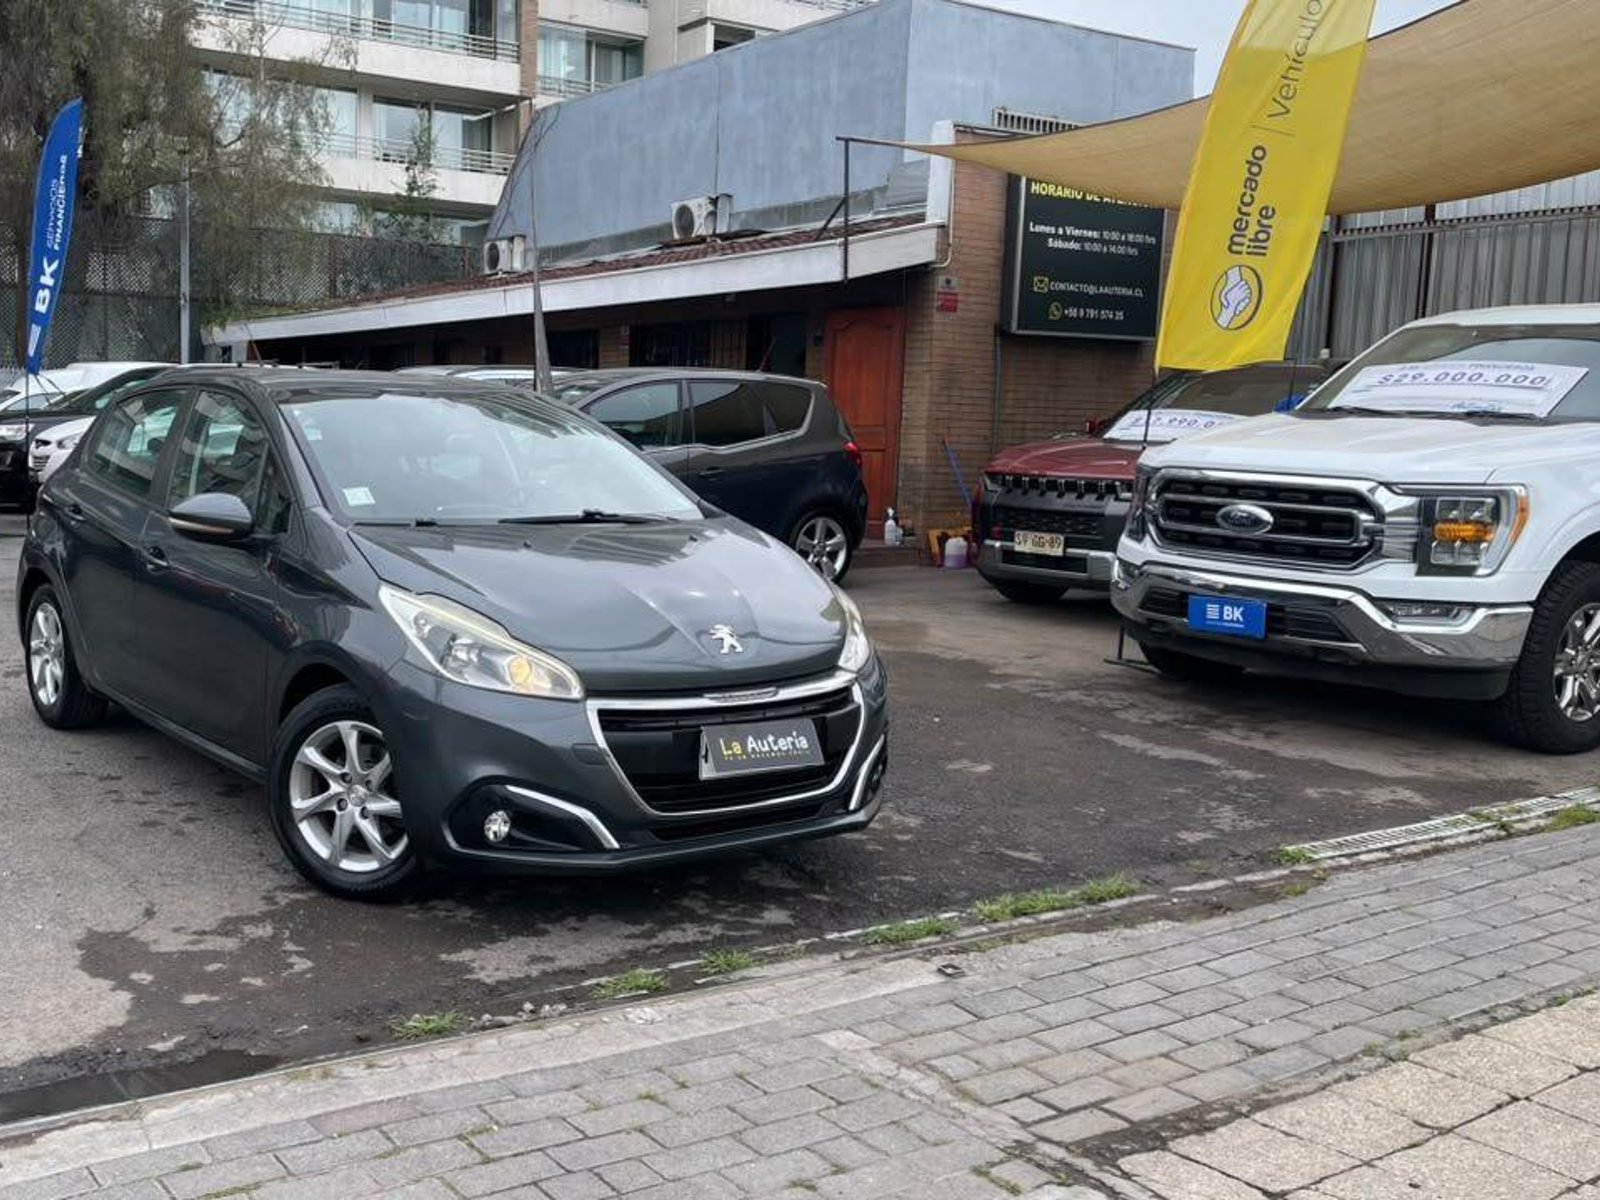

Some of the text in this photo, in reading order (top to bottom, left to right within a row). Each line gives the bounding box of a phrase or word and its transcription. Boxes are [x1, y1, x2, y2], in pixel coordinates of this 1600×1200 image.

[1227, 145, 1267, 255] mercado
[1029, 221, 1056, 234] Lunes
[1057, 226, 1064, 236] a
[1065, 226, 1101, 239] Viernes:
[1246, 205, 1276, 257] libre
[1047, 237, 1081, 250] Sábado:
[34, 257, 59, 315] BK
[1223, 605, 1244, 622] BK
[719, 737, 742, 756] La
